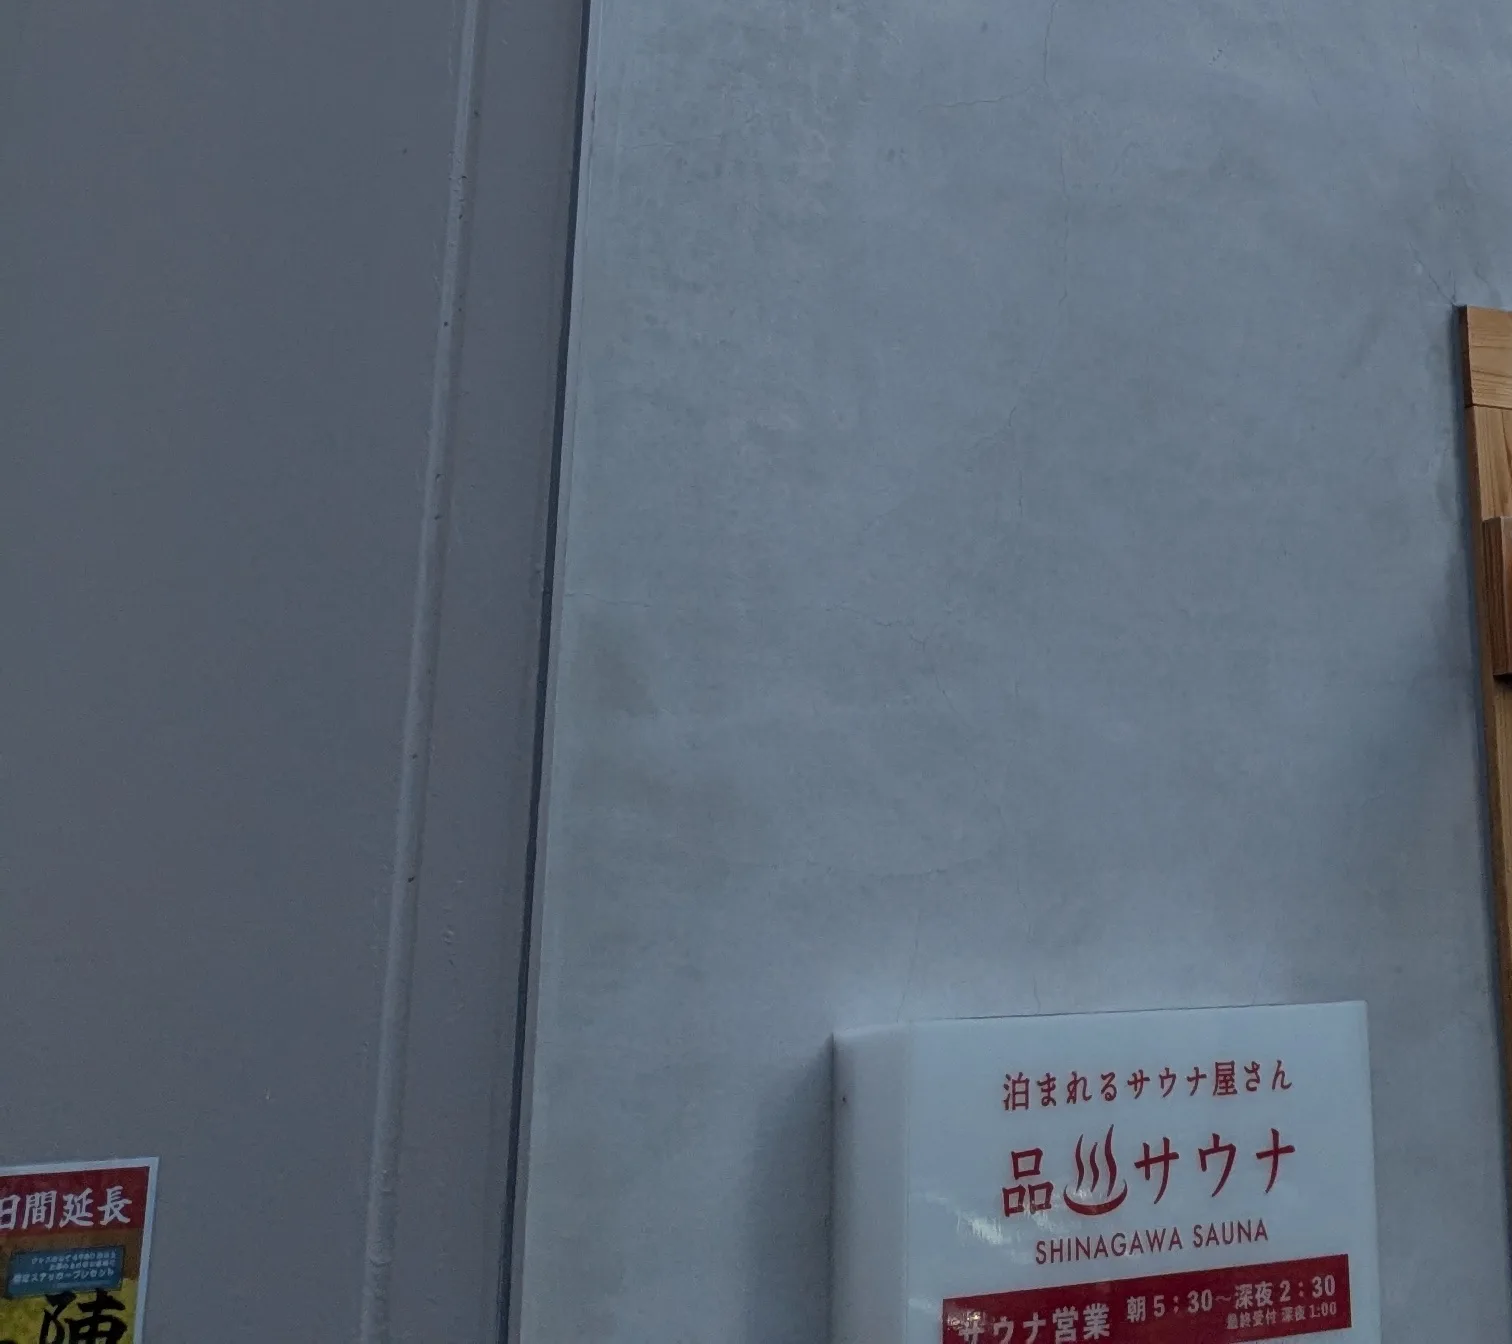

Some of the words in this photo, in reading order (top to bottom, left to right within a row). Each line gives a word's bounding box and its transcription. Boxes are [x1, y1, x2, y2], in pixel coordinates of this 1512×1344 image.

[1002, 1059, 1293, 1111] 泊まれるサウナ屋さん
[1035, 1228, 1182, 1265] SHINAGAWA
[1193, 1219, 1268, 1247] SAUNA
